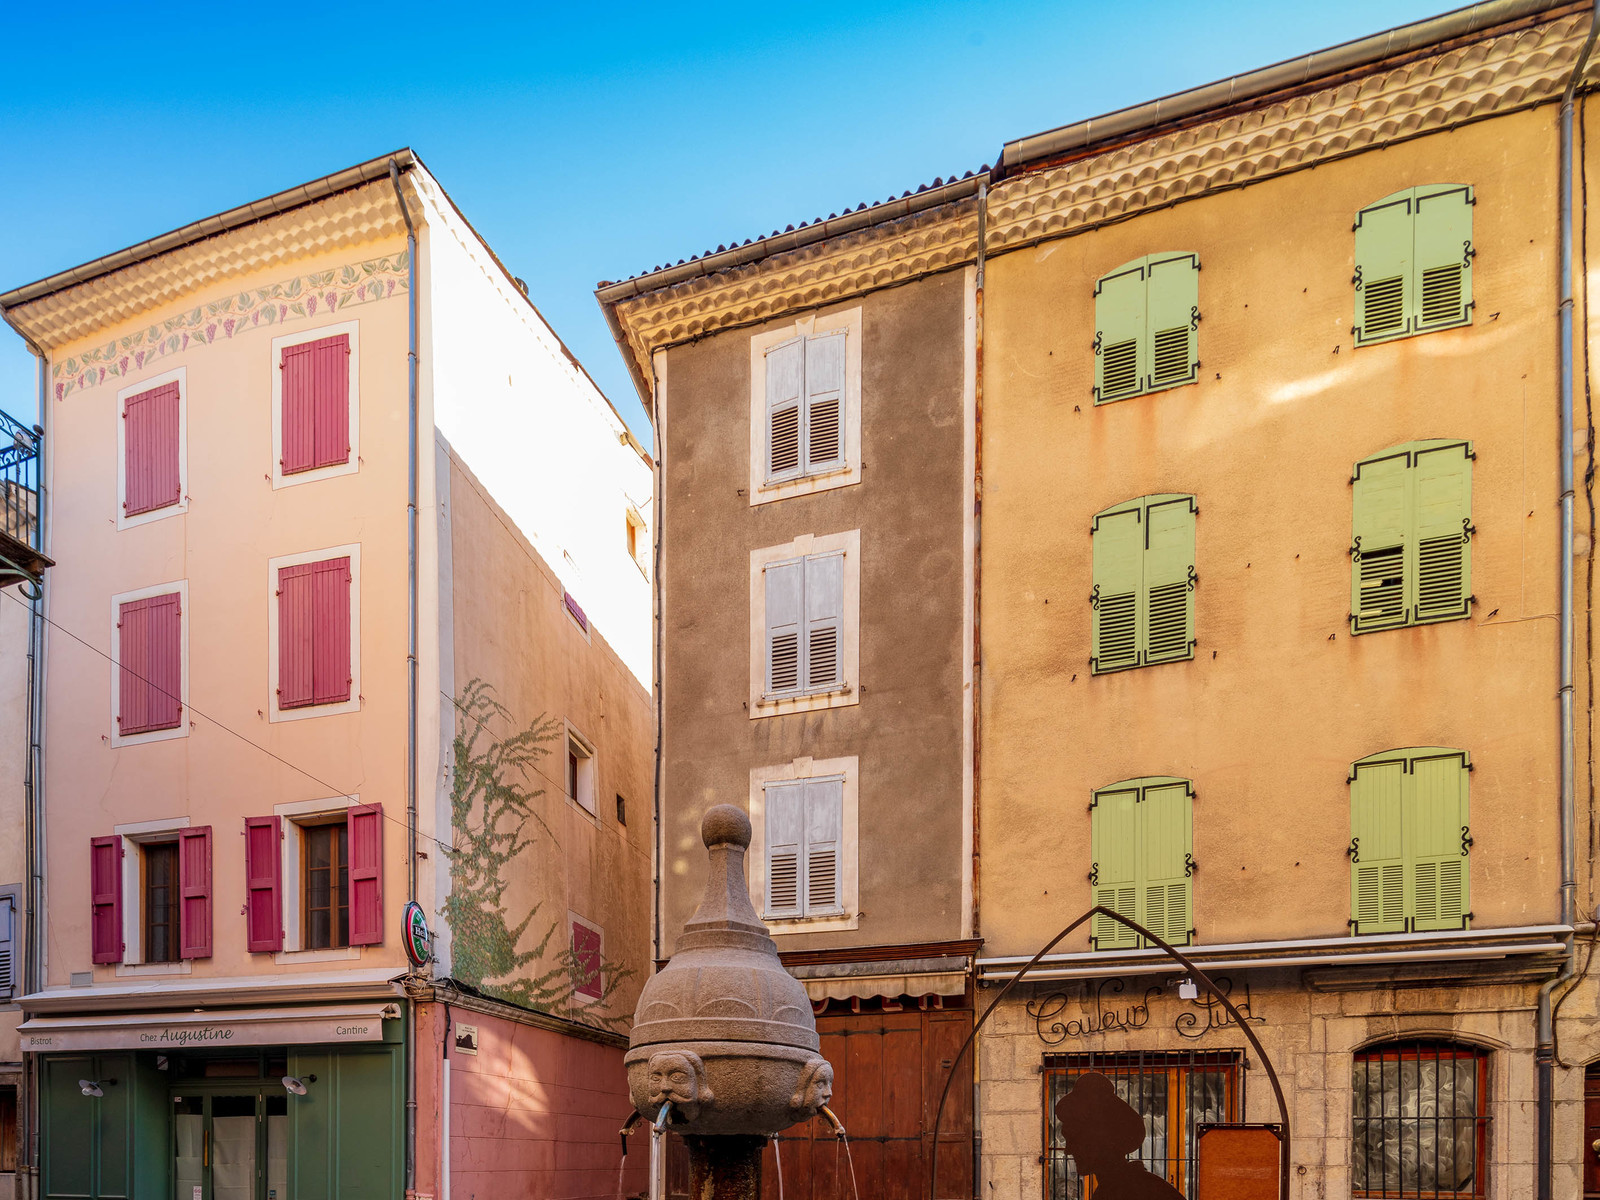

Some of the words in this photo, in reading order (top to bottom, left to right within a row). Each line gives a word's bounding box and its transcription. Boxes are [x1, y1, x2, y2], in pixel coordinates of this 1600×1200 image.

[1175, 977, 1266, 1038] Sud
[140, 1033, 158, 1042] Chez
[159, 1027, 234, 1045] Augustine
[336, 1025, 369, 1035] Cantine
[30, 1037, 52, 1045] Bistrot
